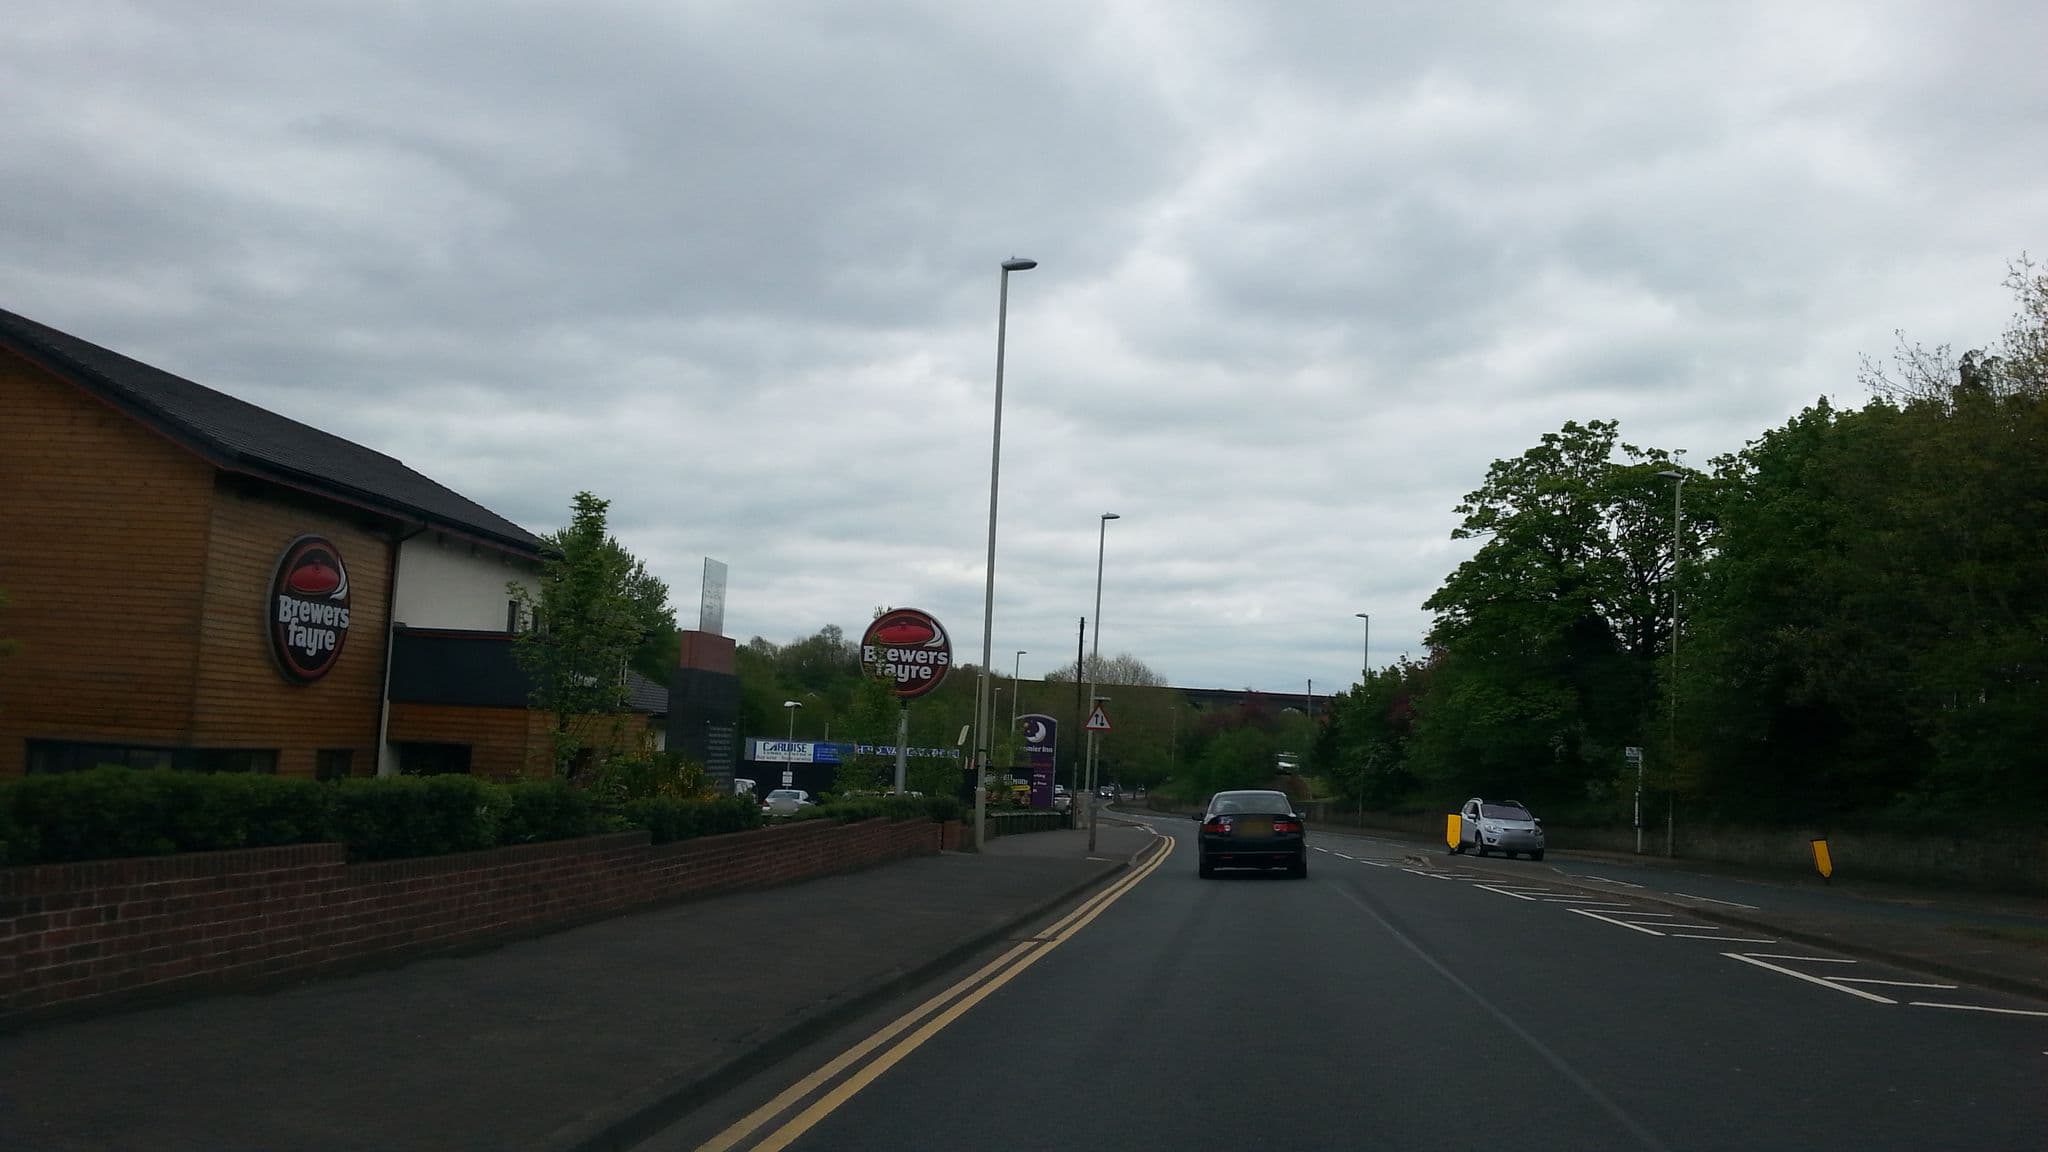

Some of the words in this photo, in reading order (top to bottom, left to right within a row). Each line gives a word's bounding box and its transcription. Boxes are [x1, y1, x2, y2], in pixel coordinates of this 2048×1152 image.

[279, 595, 349, 628] Brewers
[288, 617, 335, 656] fayre
[863, 645, 949, 665] Bewers
